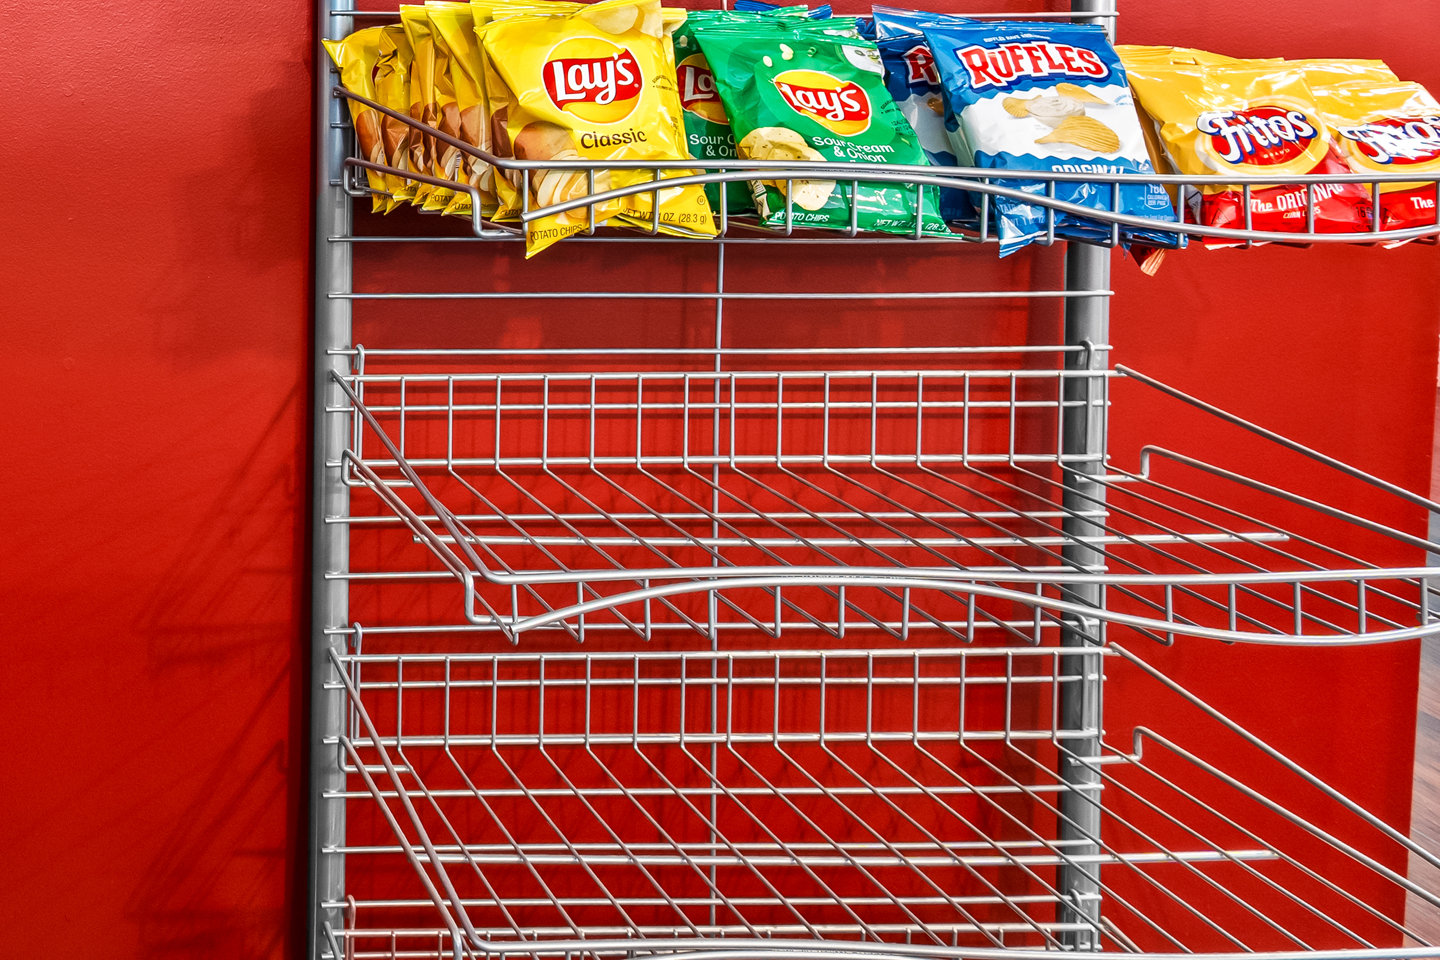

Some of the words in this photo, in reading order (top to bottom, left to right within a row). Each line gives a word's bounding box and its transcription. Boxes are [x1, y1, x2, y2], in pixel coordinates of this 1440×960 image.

[960, 44, 1105, 85] RUFFLES
[552, 52, 634, 105] Lay's
[780, 85, 861, 121] Lay's
[580, 128, 648, 149] Classic
[690, 133, 723, 146] Sour
[1197, 110, 1316, 163] Fritos
[706, 145, 717, 157] &
[812, 136, 847, 148] Sour
[847, 141, 894, 154] Cream
[1263, 147, 1291, 159] BRAND
[833, 146, 847, 158] &
[846, 147, 888, 162] Onion
[1250, 198, 1273, 212] The
[1411, 196, 1435, 209] The
[678, 214, 698, 224] (28.3
[699, 214, 707, 224] g)
[805, 213, 829, 222] CHIPS
[530, 227, 558, 241] POTATO
[559, 224, 582, 237] CHIPS
